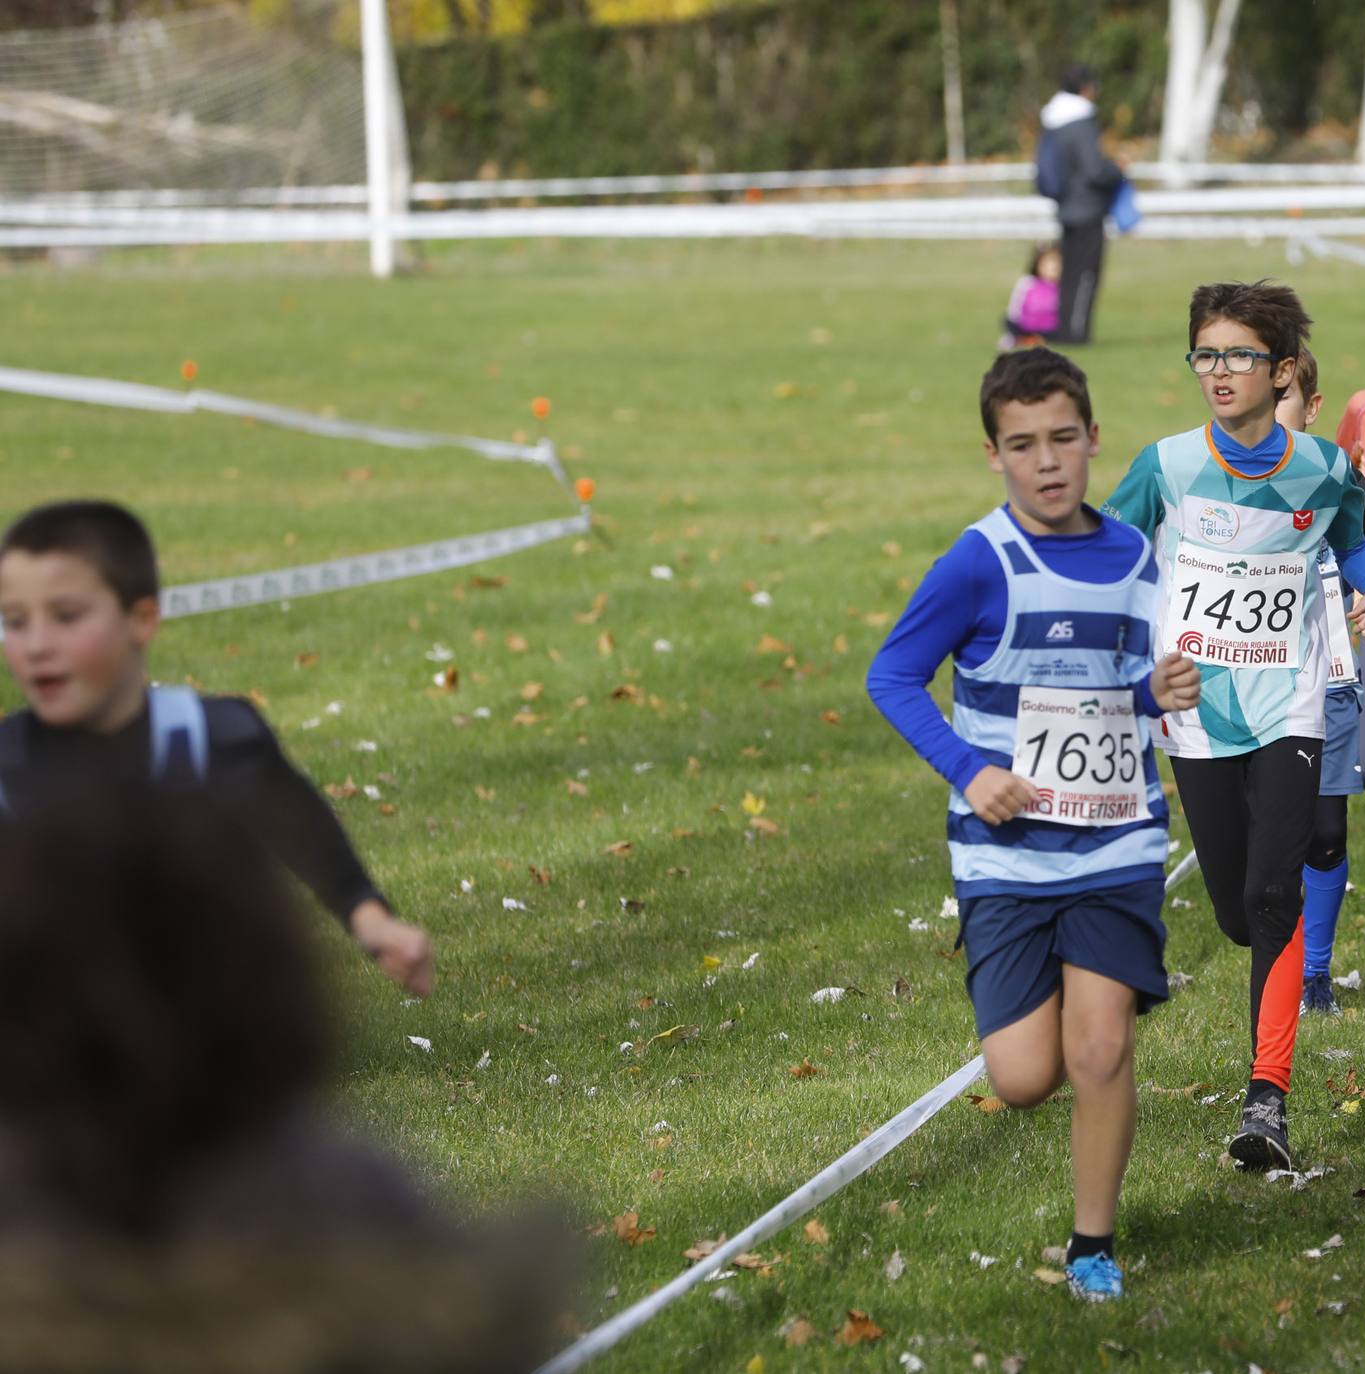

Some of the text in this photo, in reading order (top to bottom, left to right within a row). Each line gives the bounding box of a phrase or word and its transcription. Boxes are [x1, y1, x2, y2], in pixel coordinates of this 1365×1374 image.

[1200, 519, 1217, 528] TRI
[1200, 528, 1233, 538] TONES
[1178, 553, 1304, 577] Gobierno de La Rioja
[1180, 581, 1297, 634] 1438
[1207, 636, 1288, 649] FEDERACIÓN RIOJANA DE
[1206, 644, 1287, 664] ATLETISMO
[1021, 700, 1076, 715] Gobierno
[1026, 729, 1137, 784] 1635
[1059, 801, 1137, 820] ATLETISMO
